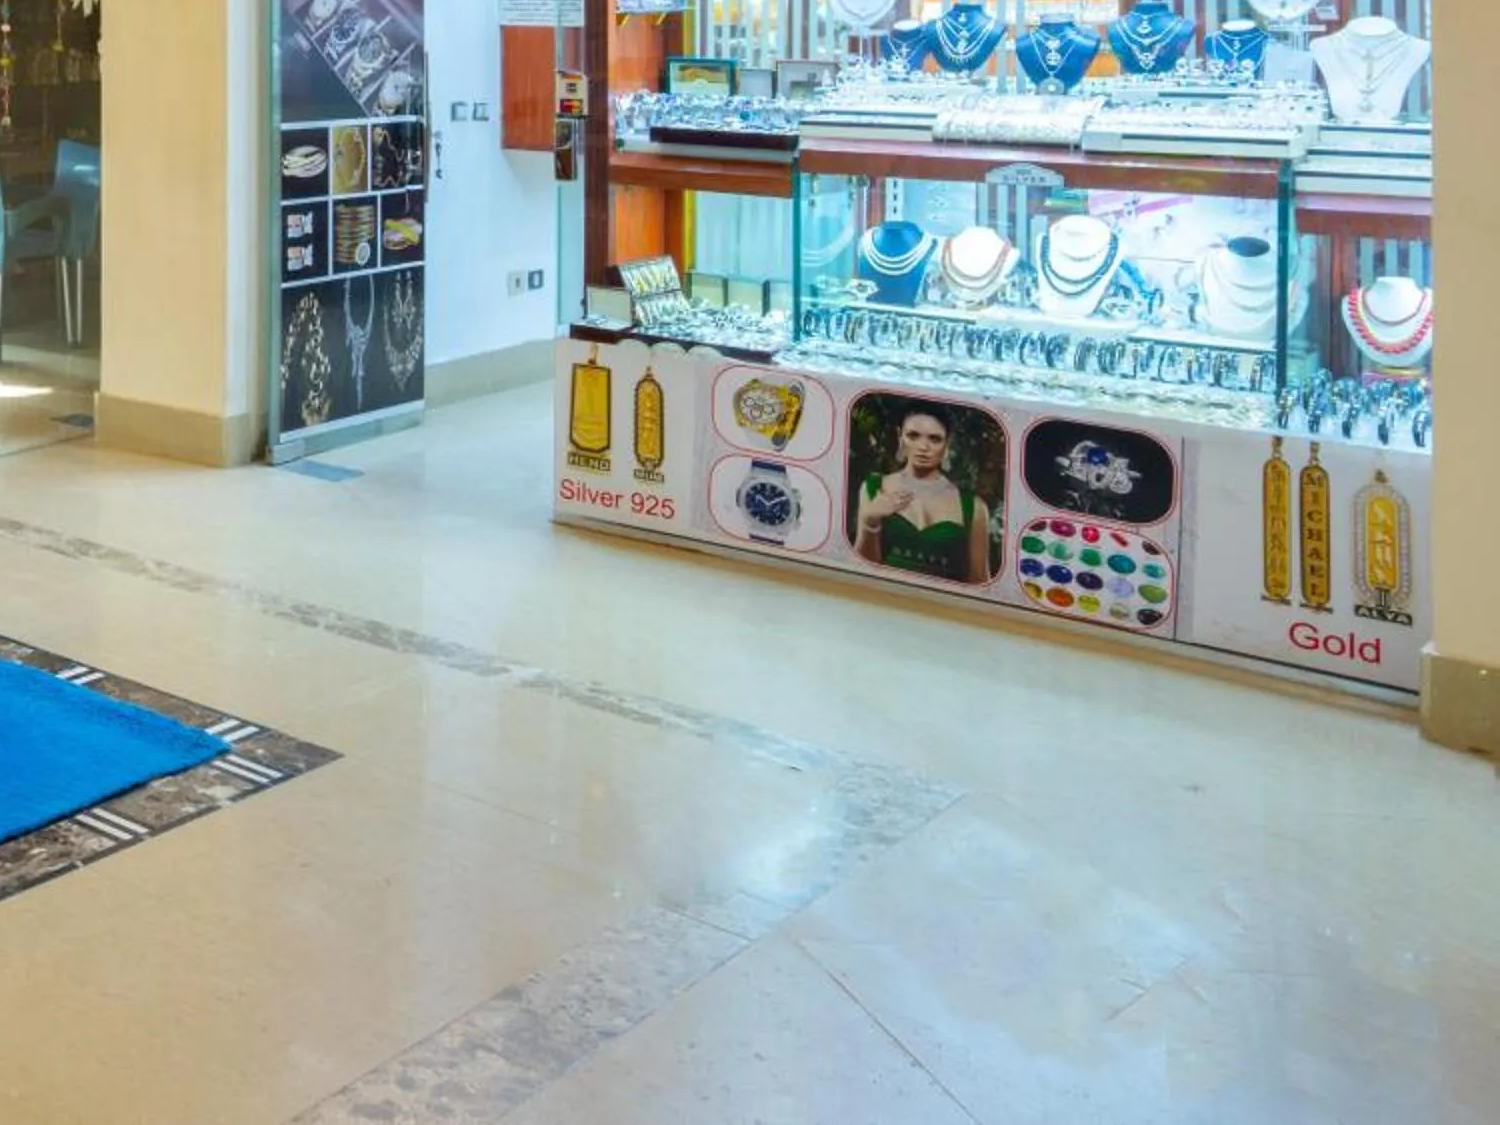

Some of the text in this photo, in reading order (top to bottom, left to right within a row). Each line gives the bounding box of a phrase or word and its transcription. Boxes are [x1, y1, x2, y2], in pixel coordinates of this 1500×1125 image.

[560, 478, 676, 520] Silver 925
[1305, 473, 1325, 597] MICHAEL
[1289, 622, 1382, 665] Gold
